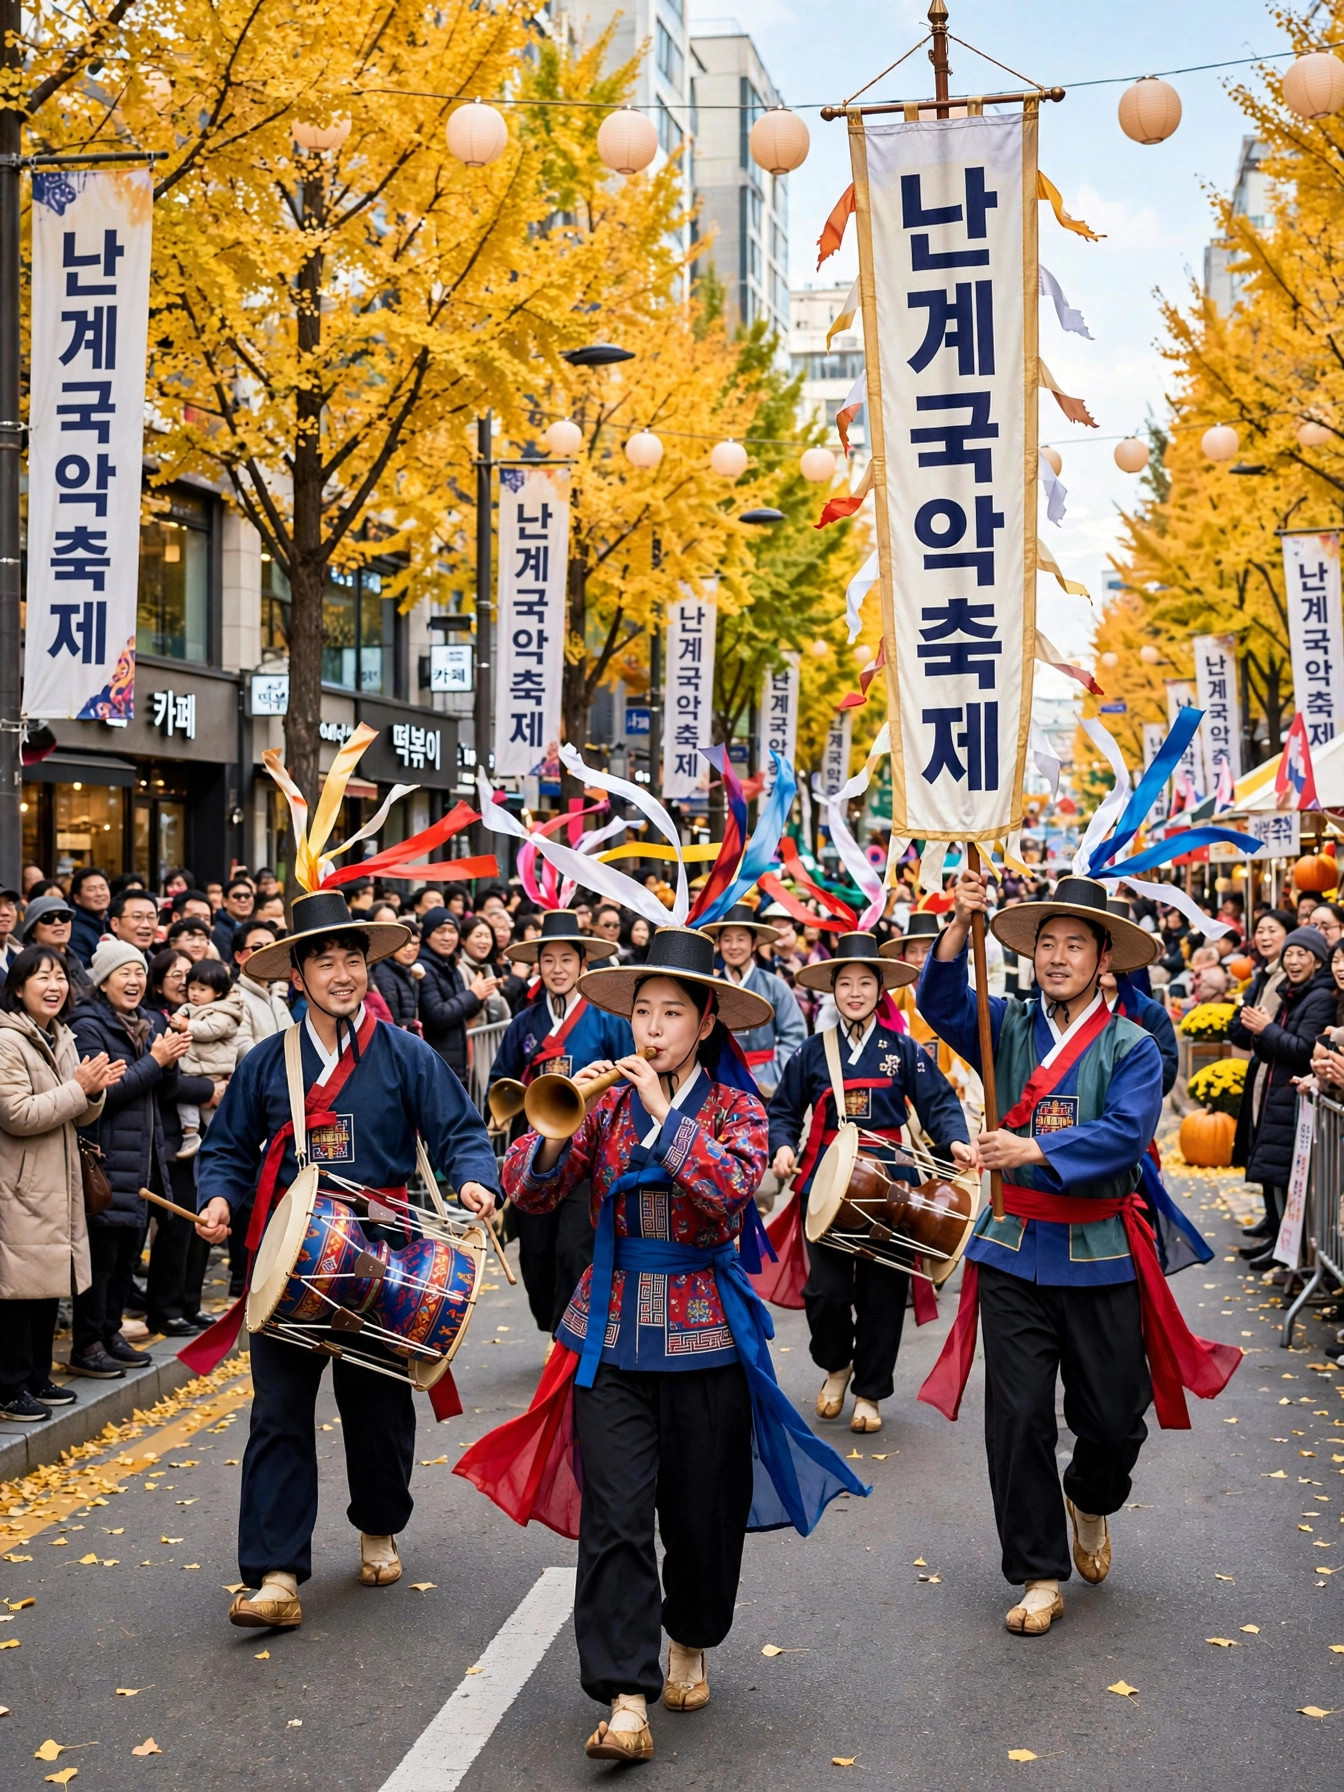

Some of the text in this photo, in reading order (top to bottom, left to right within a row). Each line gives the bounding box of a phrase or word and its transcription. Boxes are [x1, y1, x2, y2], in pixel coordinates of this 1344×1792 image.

[47, 229, 125, 666] 난계국악축제
[900, 166, 1005, 791] 난계국악축제
[153, 689, 196, 740] 카페
[509, 502, 553, 748] 난계국악축제
[674, 606, 705, 777] 난계국악축제
[1299, 561, 1335, 746] 난계국악축제
[393, 723, 441, 771] 떡볶이
